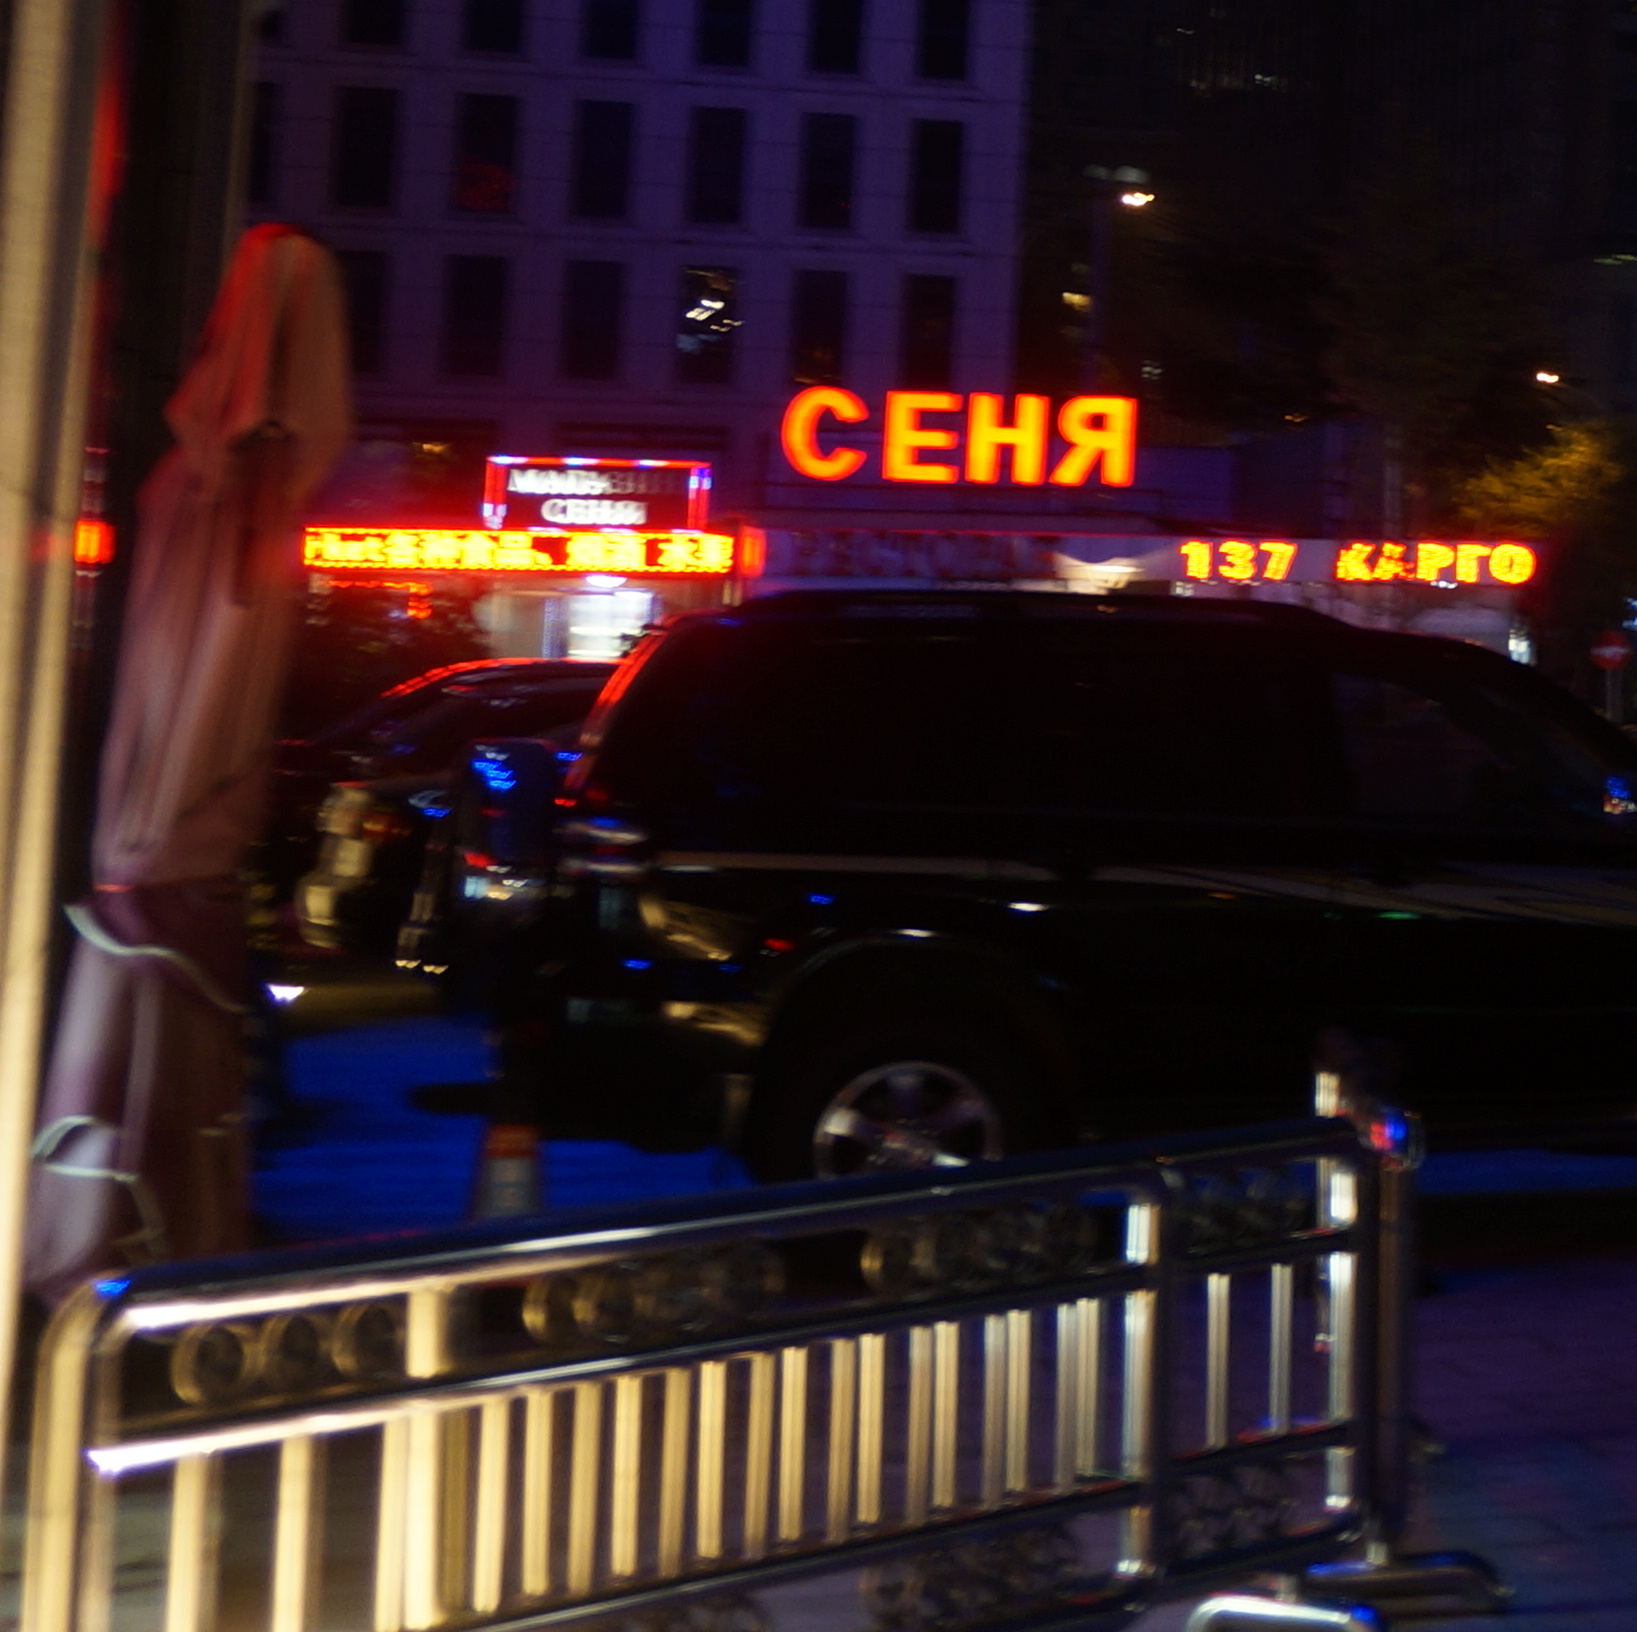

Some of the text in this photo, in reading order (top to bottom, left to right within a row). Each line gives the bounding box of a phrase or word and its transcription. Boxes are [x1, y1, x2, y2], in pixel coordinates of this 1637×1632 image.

[781, 385, 1138, 487] СЕНЯ
[1178, 540, 1536, 584] 137 КАРГО
